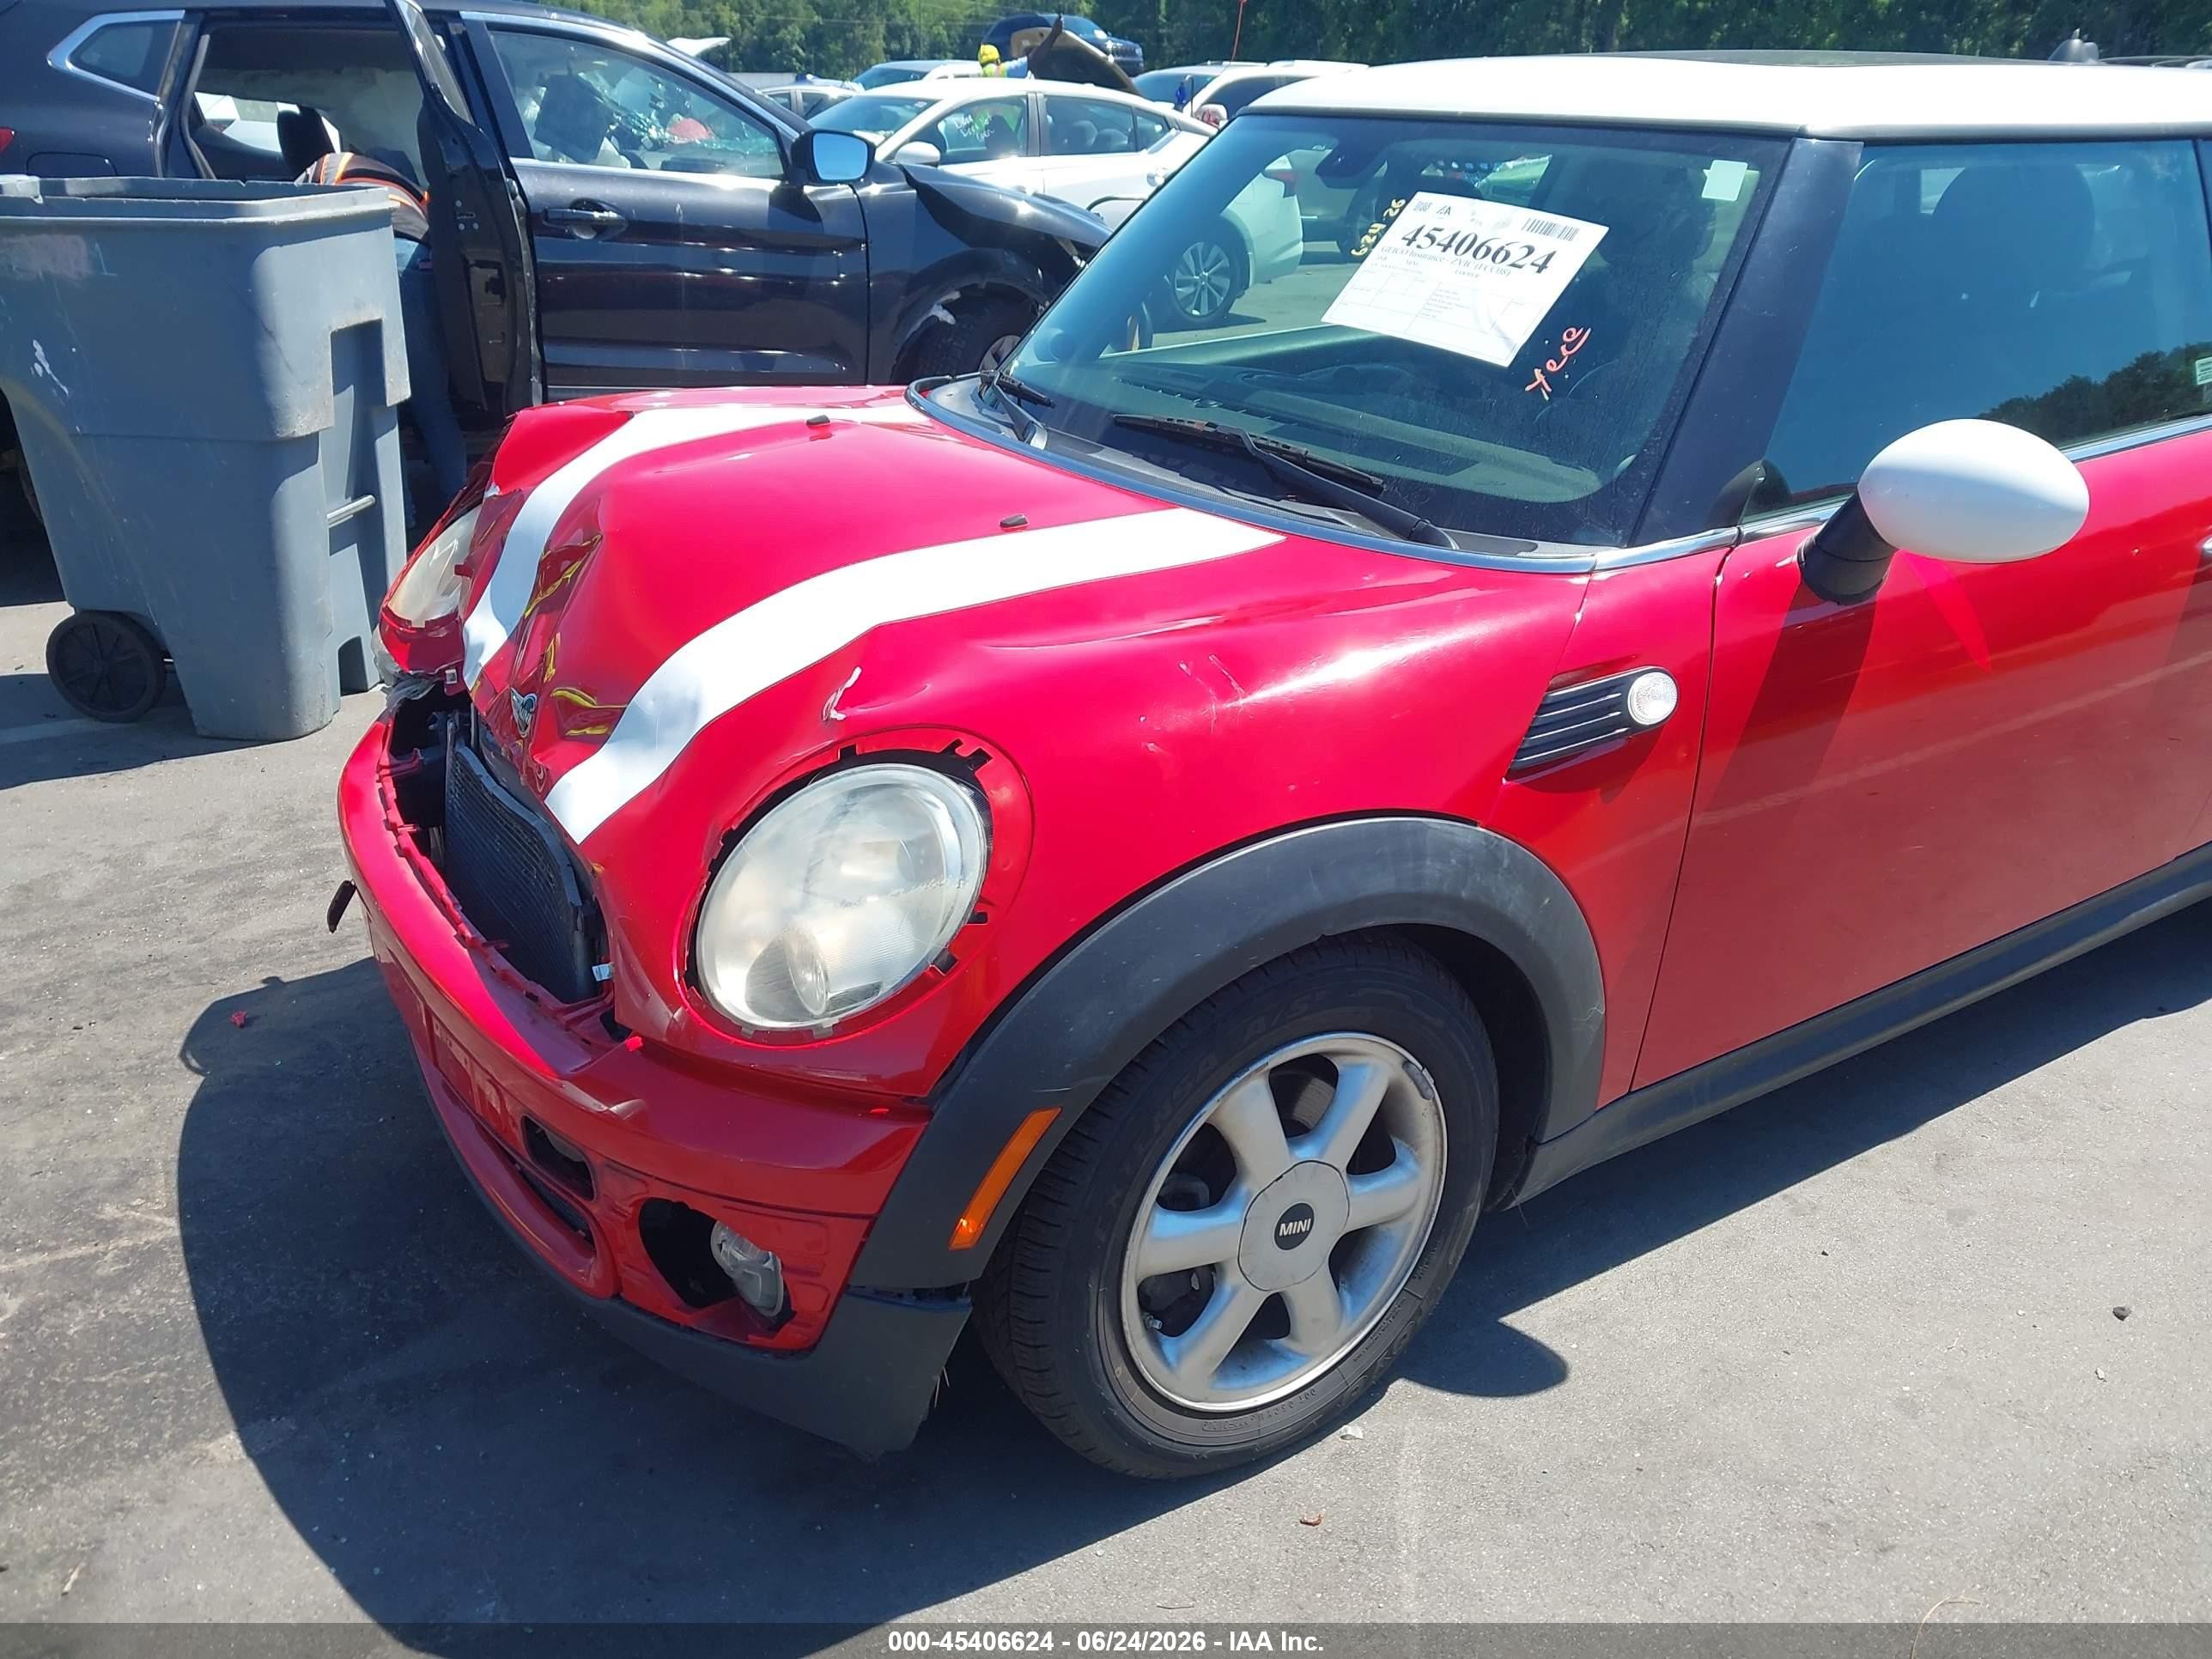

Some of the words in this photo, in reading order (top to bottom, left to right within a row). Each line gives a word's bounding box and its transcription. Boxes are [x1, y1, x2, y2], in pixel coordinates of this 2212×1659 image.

[1381, 246, 1409, 255] GEICO
[1409, 250, 1446, 262] Insurance
[1401, 224, 1557, 274] 45406624
[1279, 1218, 1311, 1237] MINI
